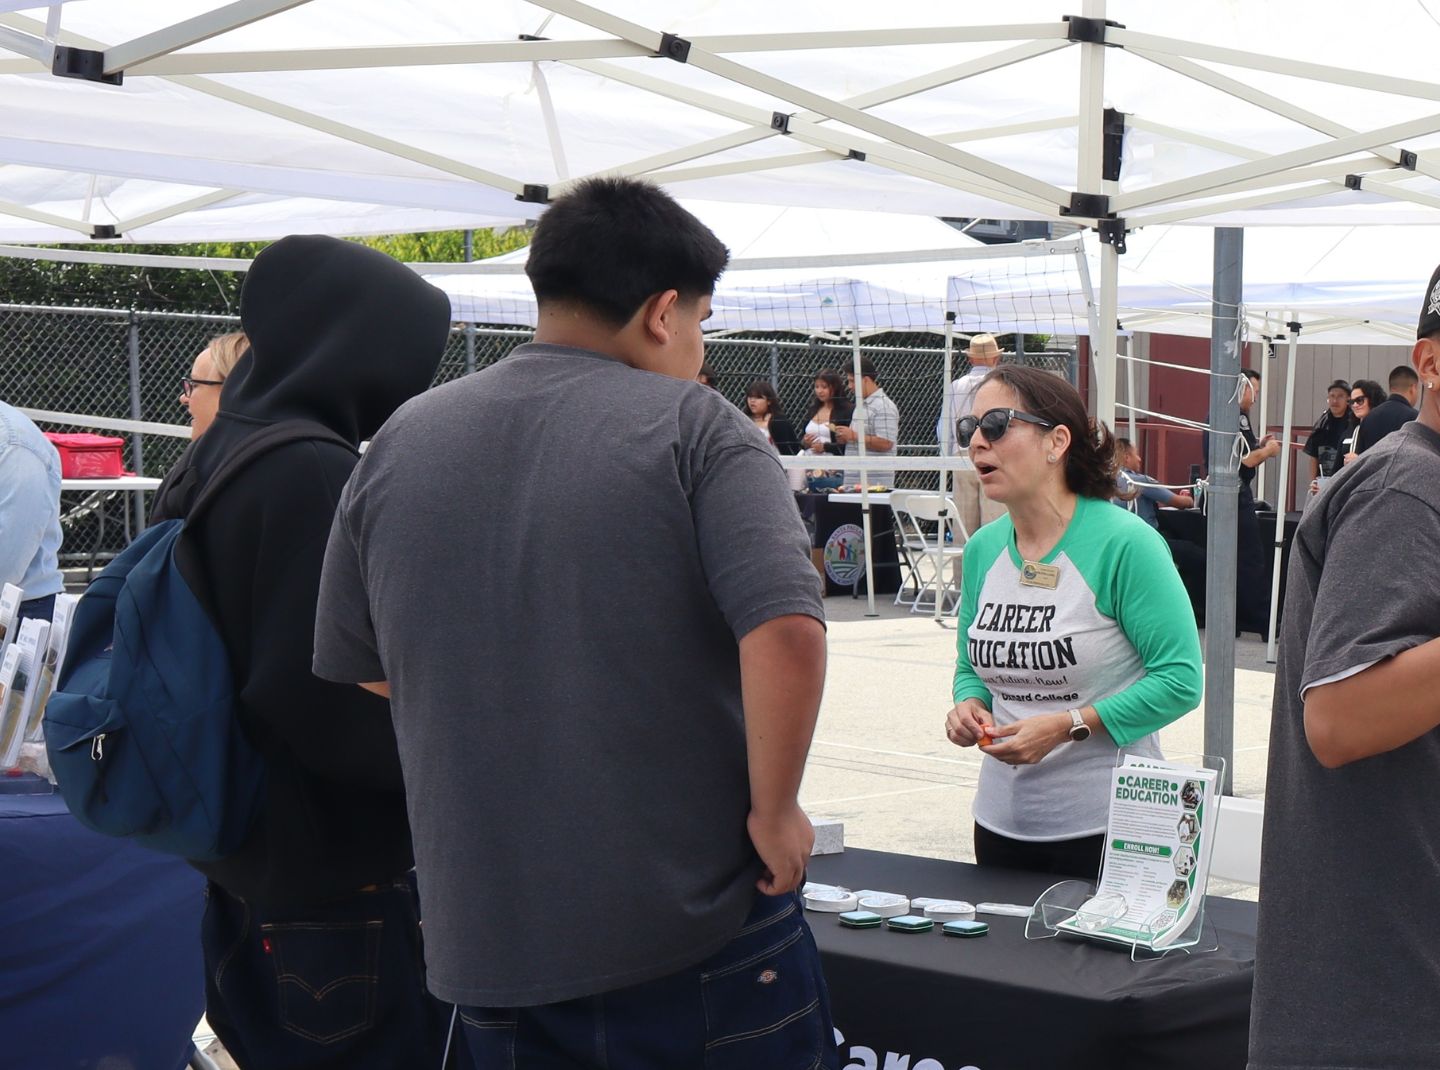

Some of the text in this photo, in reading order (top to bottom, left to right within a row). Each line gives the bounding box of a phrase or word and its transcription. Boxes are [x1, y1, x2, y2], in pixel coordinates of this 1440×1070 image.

[976, 602, 1057, 634] CAREER
[969, 636, 1078, 671] DUCATION
[1034, 692, 1079, 703] College
[1126, 775, 1170, 793] CAREER
[1115, 787, 1178, 806] EDUCATION
[1123, 842, 1160, 854] ENROLL NOW!
